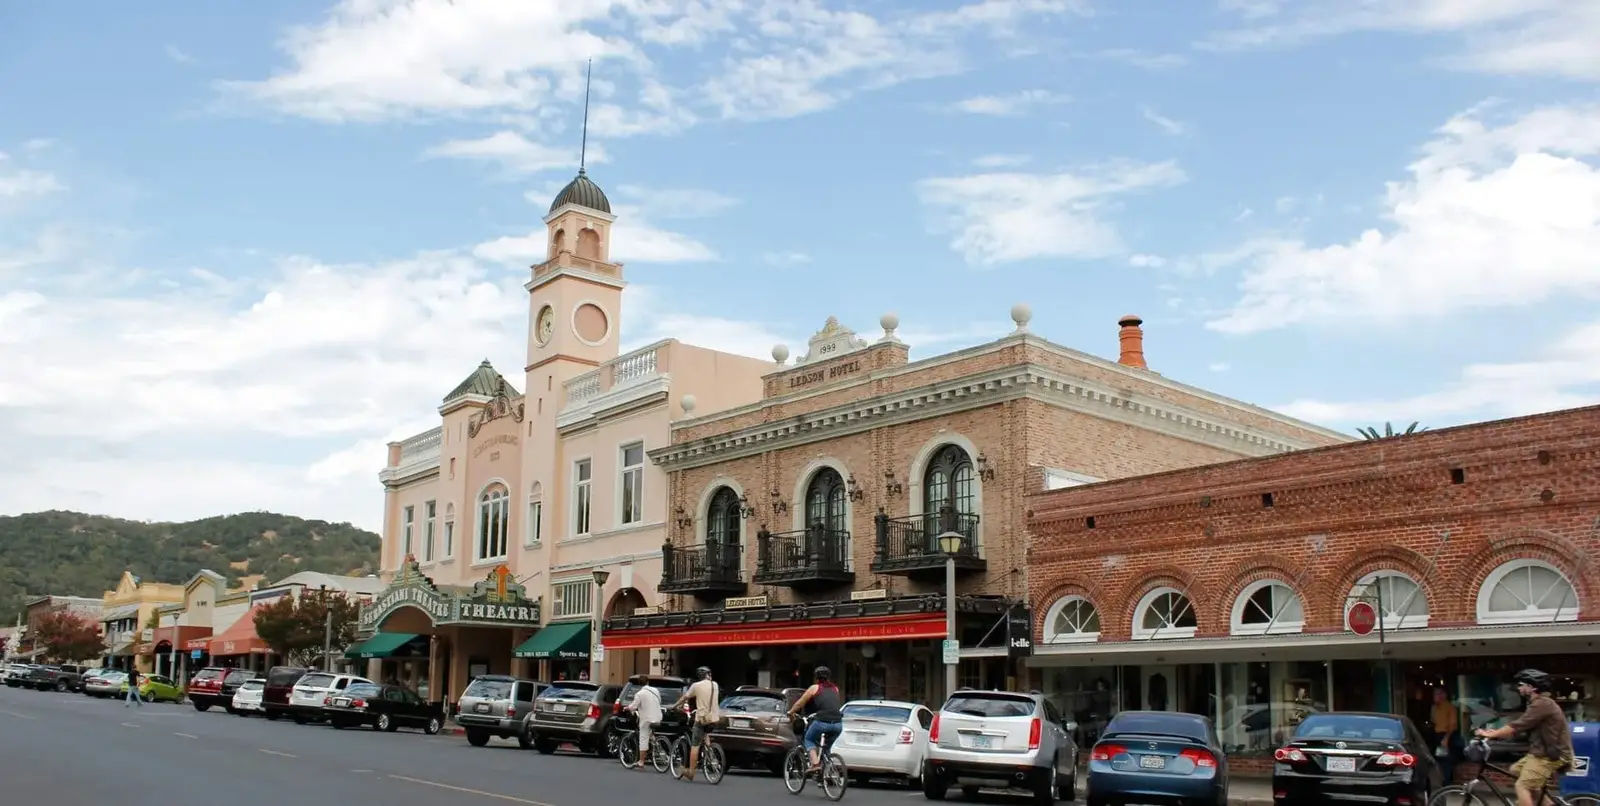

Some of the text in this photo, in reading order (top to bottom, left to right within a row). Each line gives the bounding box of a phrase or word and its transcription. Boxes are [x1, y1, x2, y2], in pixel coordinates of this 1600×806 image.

[820, 343, 836, 354] 1999
[790, 361, 861, 388] LEDSON HOTEL
[364, 587, 449, 625] SEBASTIANI THEATRE
[748, 597, 765, 606] HOTEL
[461, 603, 539, 621] THEATRE
[559, 650, 577, 658] Sports
